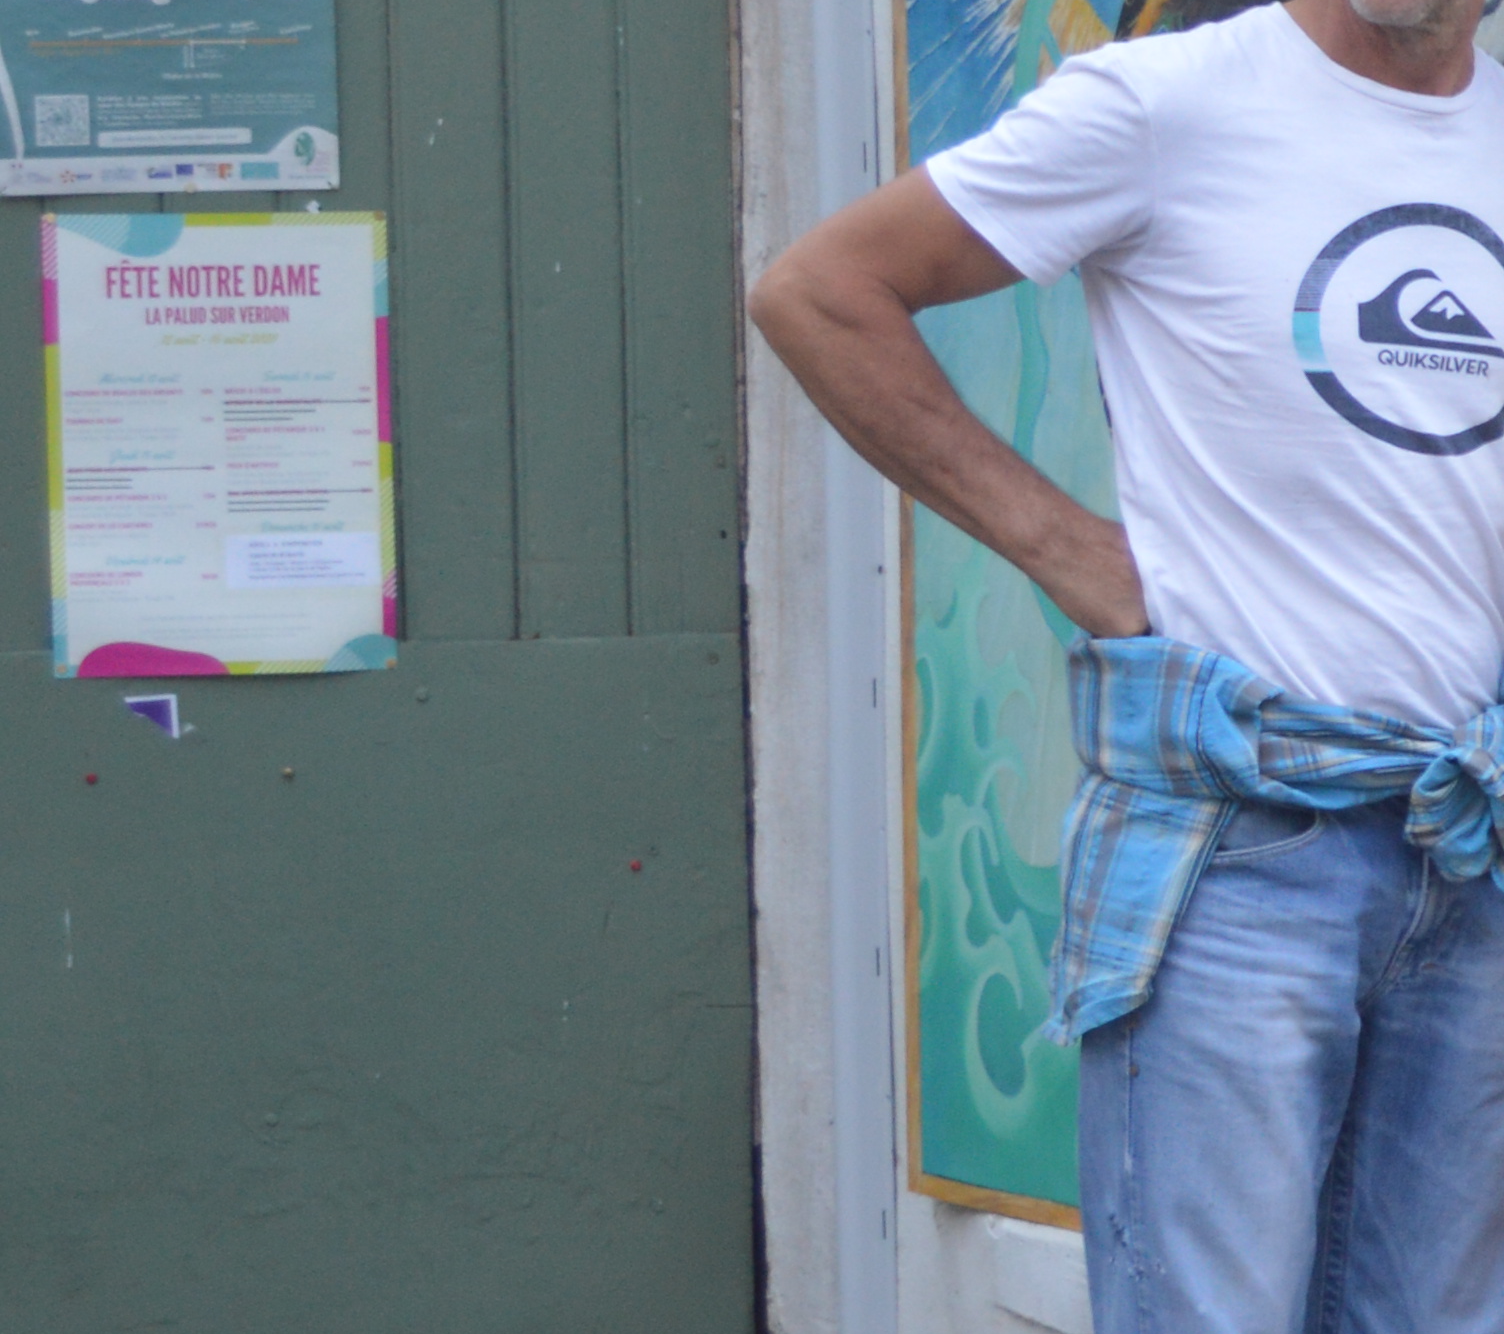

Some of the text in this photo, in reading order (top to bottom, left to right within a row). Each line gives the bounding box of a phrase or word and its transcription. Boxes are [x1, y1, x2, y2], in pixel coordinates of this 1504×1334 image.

[106, 259, 321, 299] FÊTE NOTRE DAME
[145, 305, 290, 326] LA PALUD SUR VERDON
[1377, 349, 1489, 376] QUIKSILVER
